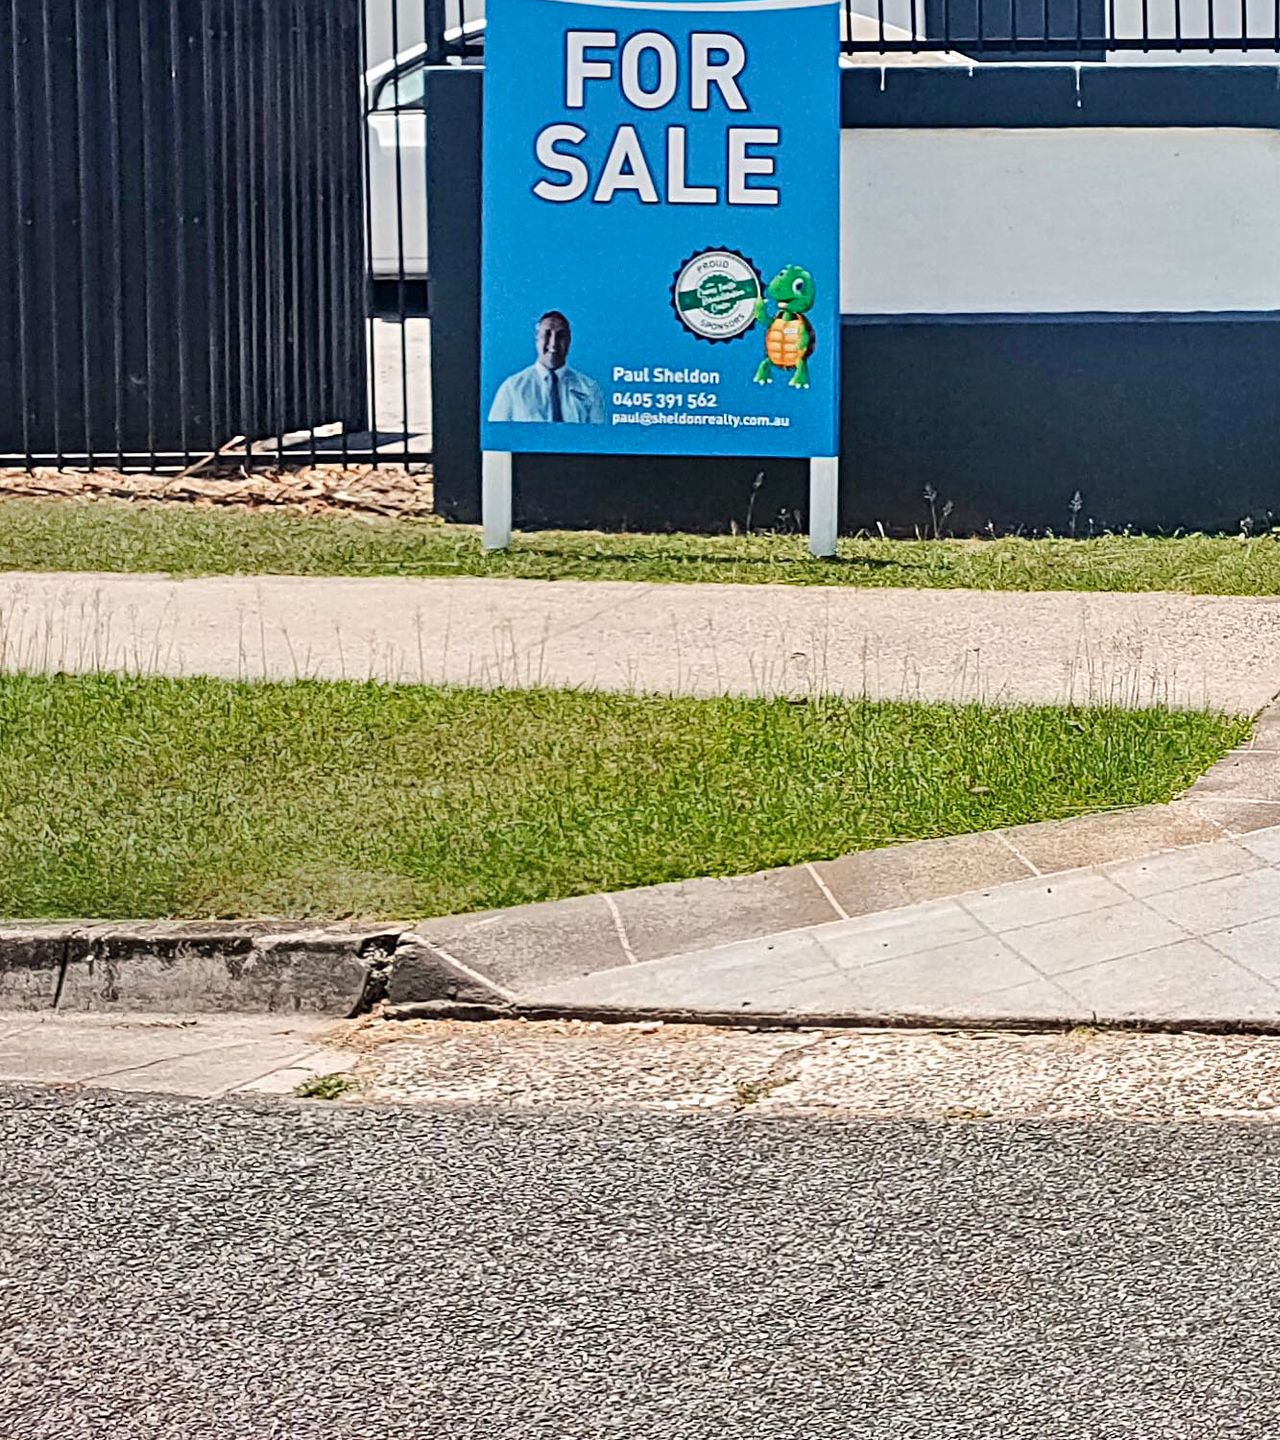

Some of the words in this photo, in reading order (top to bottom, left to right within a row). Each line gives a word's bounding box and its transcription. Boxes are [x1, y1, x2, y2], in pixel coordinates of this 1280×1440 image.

[565, 30, 748, 111] FOR
[532, 124, 780, 205] SALE
[697, 260, 730, 273] PROUD
[701, 313, 745, 330] SPONSORS
[612, 367, 650, 382] Paul
[653, 367, 720, 384] Sheldon
[612, 392, 652, 408] 0405
[655, 393, 683, 409] 391
[687, 393, 718, 408] 562
[612, 412, 790, 428] paul@sheldonrealty.com.au
